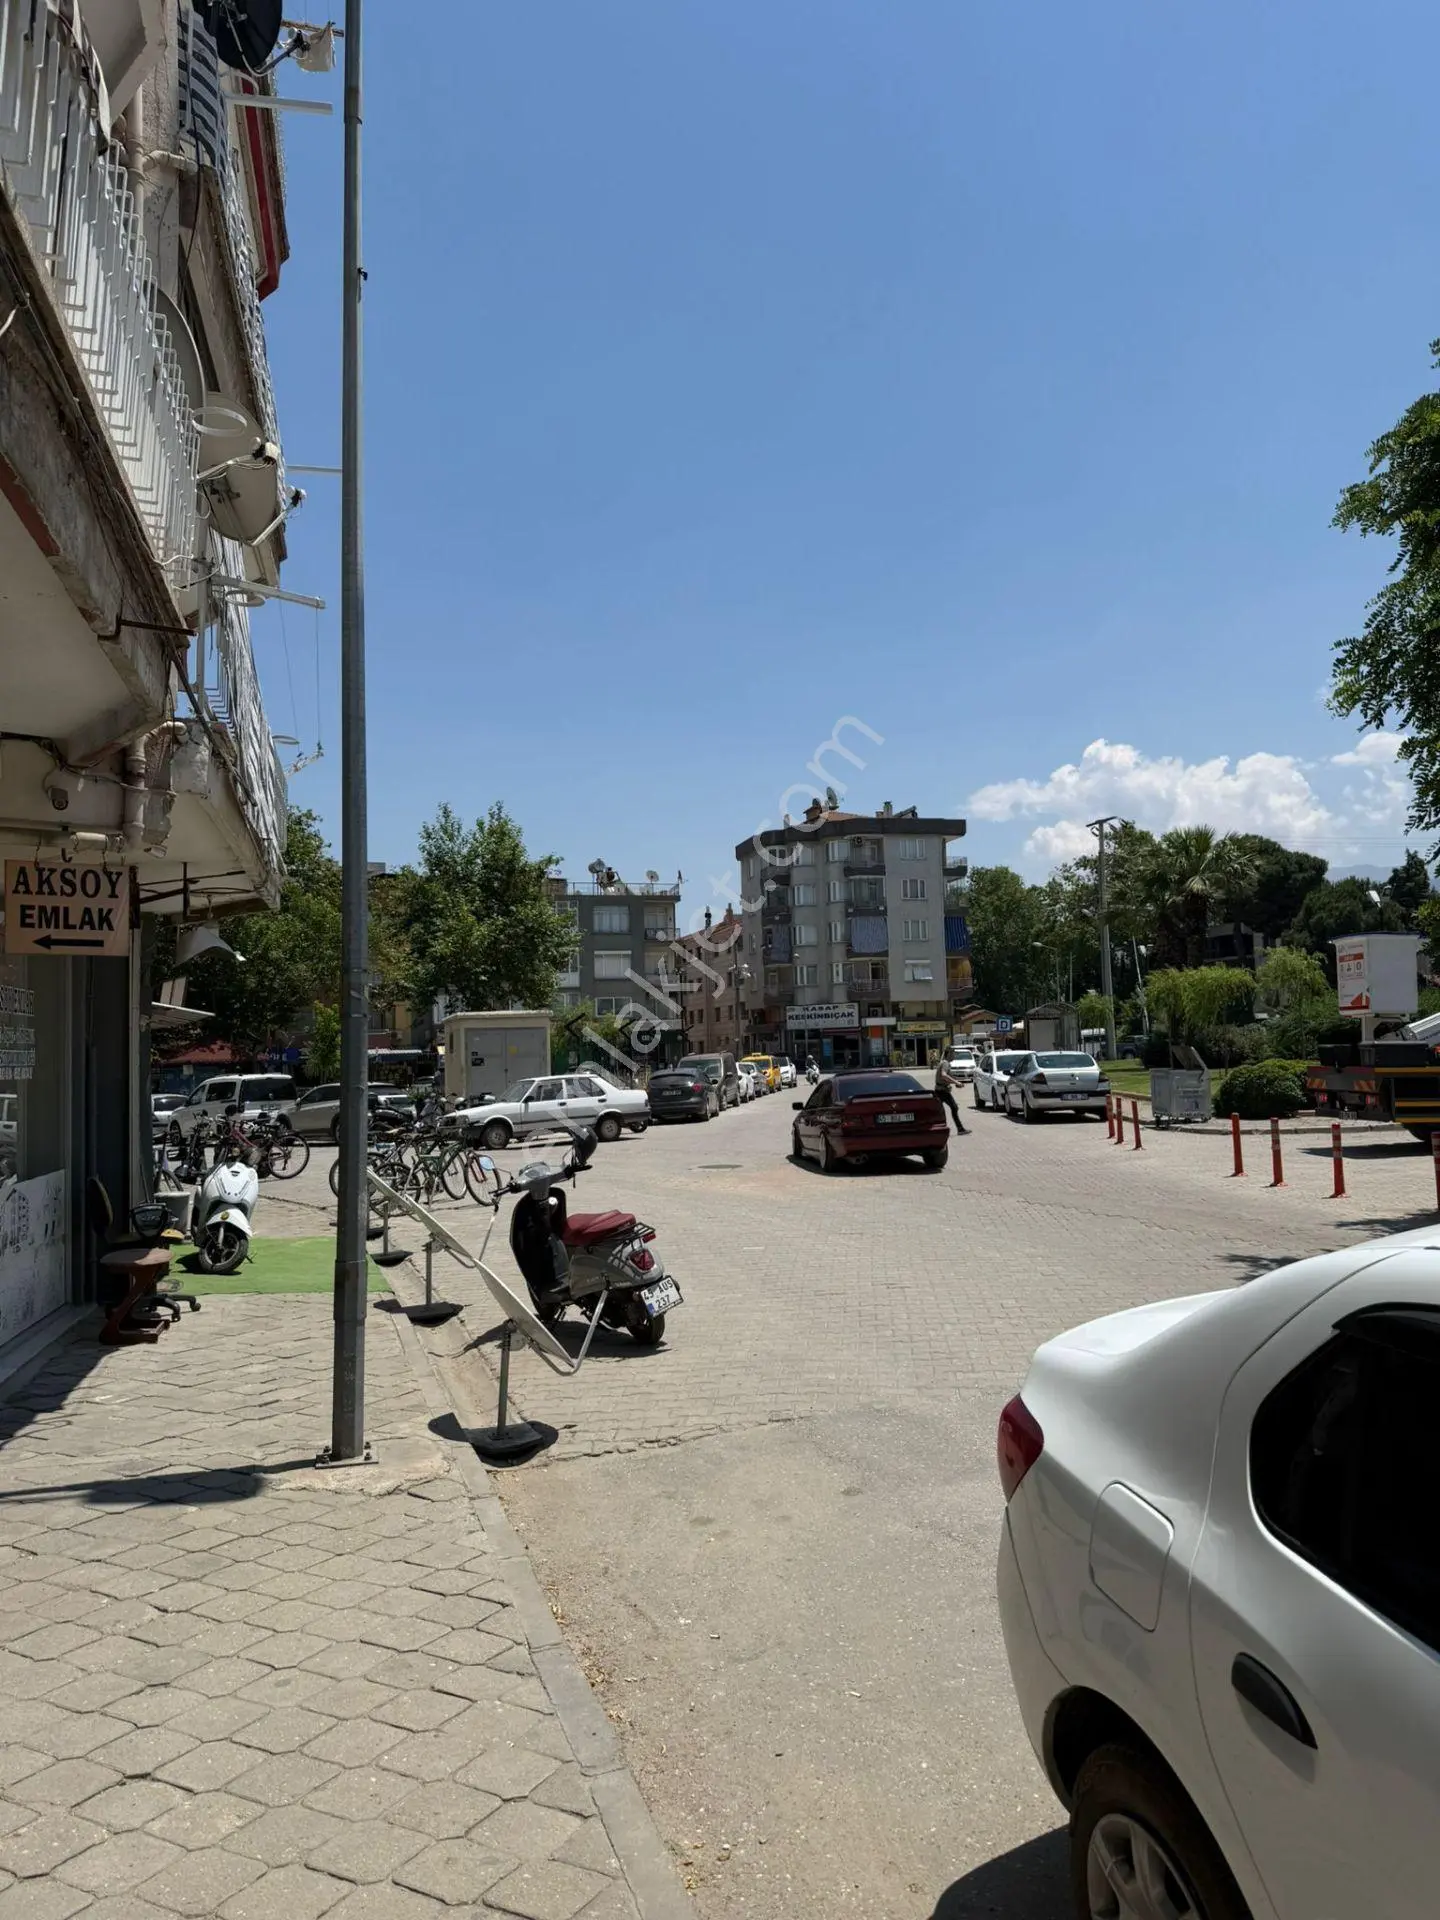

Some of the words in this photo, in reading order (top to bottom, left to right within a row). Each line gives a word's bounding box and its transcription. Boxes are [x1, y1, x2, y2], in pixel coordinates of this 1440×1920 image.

[12, 866, 122, 898] AKSOY
[20, 904, 114, 931] EMLAK
[644, 1287, 655, 1300] 45
[659, 1279, 674, 1294] AUS
[655, 1294, 671, 1310] 237
